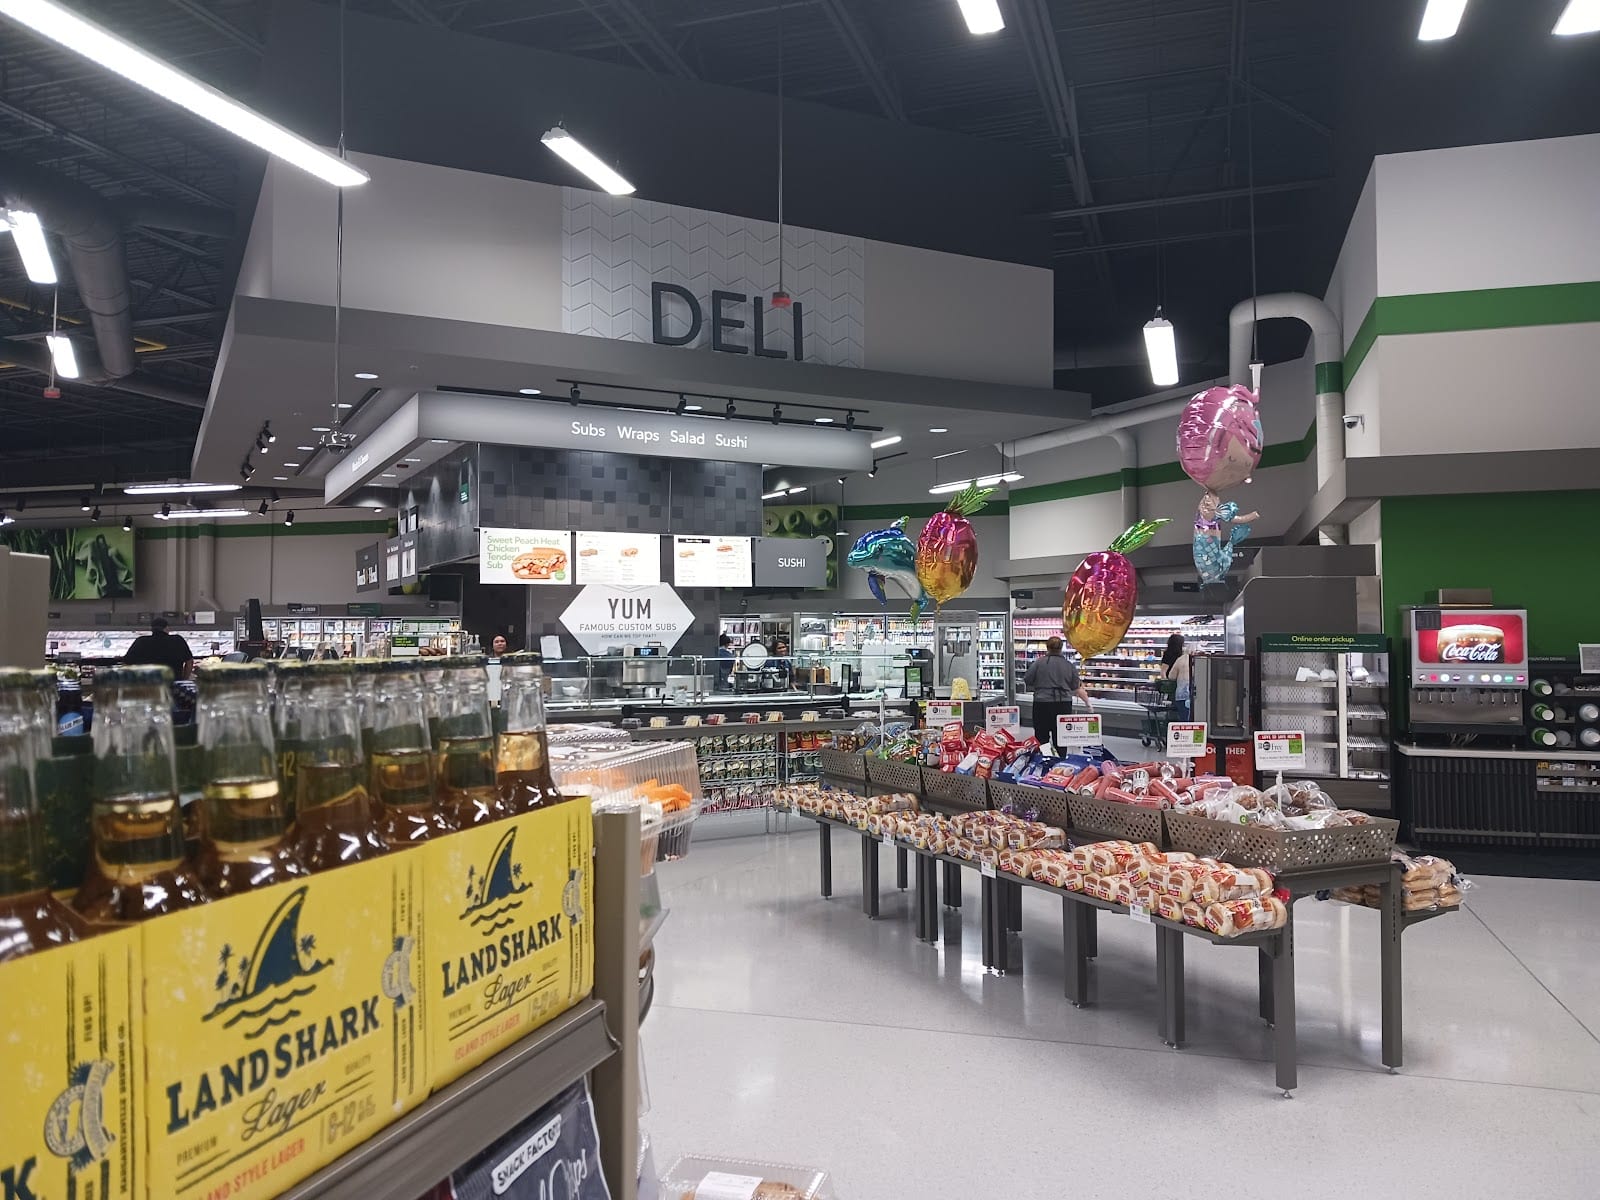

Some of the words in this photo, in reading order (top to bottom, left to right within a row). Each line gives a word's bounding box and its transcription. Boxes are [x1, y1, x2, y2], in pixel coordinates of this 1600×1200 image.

[651, 281, 804, 361] DELI
[571, 421, 606, 437] Subs
[617, 425, 660, 443] Wraps
[670, 430, 705, 445] Salad
[715, 433, 748, 449] Sushi
[487, 535, 513, 544] Sweet
[515, 536, 539, 545] Peach
[540, 537, 561, 545] Heat
[487, 544, 520, 553] Chicken
[487, 560, 504, 569] Sub
[778, 557, 806, 568] SUSHI
[608, 598, 651, 620] YUM
[579, 623, 615, 632] FAMOUS
[618, 623, 652, 631] CUSTOM
[655, 623, 677, 631] SUBS
[1291, 635, 1312, 643] Online
[1313, 635, 1332, 643] order
[442, 913, 563, 998] LANDSHARK
[484, 973, 532, 1010] Lager
[166, 996, 381, 1135] LANDSHARK
[241, 1080, 327, 1142] Lager
[177, 1137, 218, 1166] PREMIUM
[233, 1160, 268, 1193] STYLE
[271, 1137, 306, 1171] LAGER
[497, 1151, 526, 1188] SNACK
